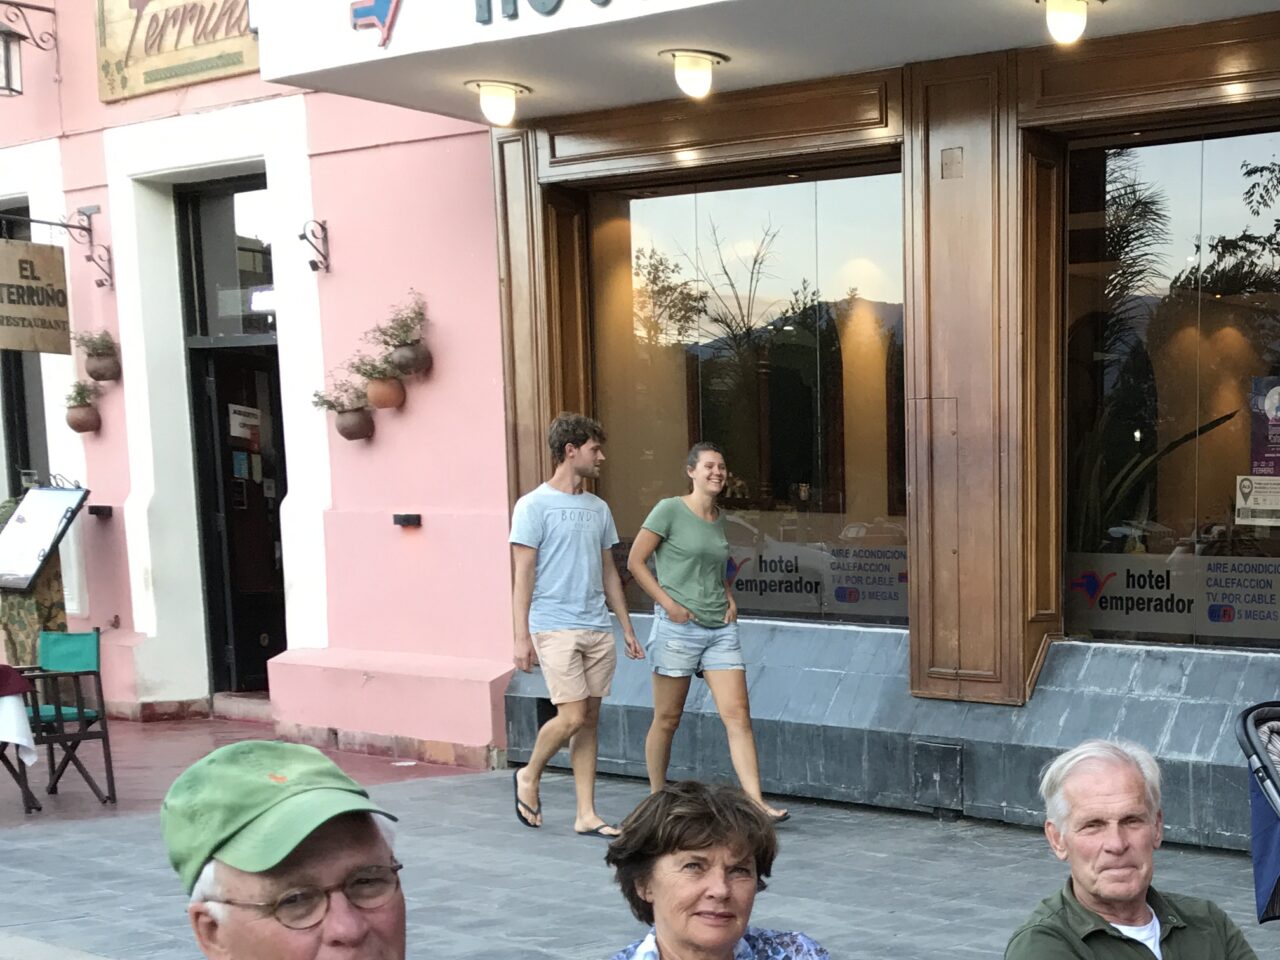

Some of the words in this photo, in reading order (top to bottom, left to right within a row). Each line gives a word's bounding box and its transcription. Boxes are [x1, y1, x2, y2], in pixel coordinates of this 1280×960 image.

[18, 258, 40, 281] EL
[831, 548, 849, 558] AIRE
[759, 554, 799, 574] hotel
[830, 562, 891, 572] CALEFACCION
[1207, 562, 1228, 573] AIRE
[845, 575, 863, 585] POR
[865, 576, 894, 586] CABLE
[1126, 569, 1170, 590] hotel
[1206, 577, 1273, 589] CALEFACCION
[735, 577, 820, 596] emperador
[868, 591, 900, 601] MEGAS
[1221, 593, 1241, 604] POR
[1244, 593, 1276, 605] CABLE
[1099, 594, 1194, 615] emperador
[1237, 609, 1242, 620] 5
[1245, 609, 1279, 621] MEGAS
